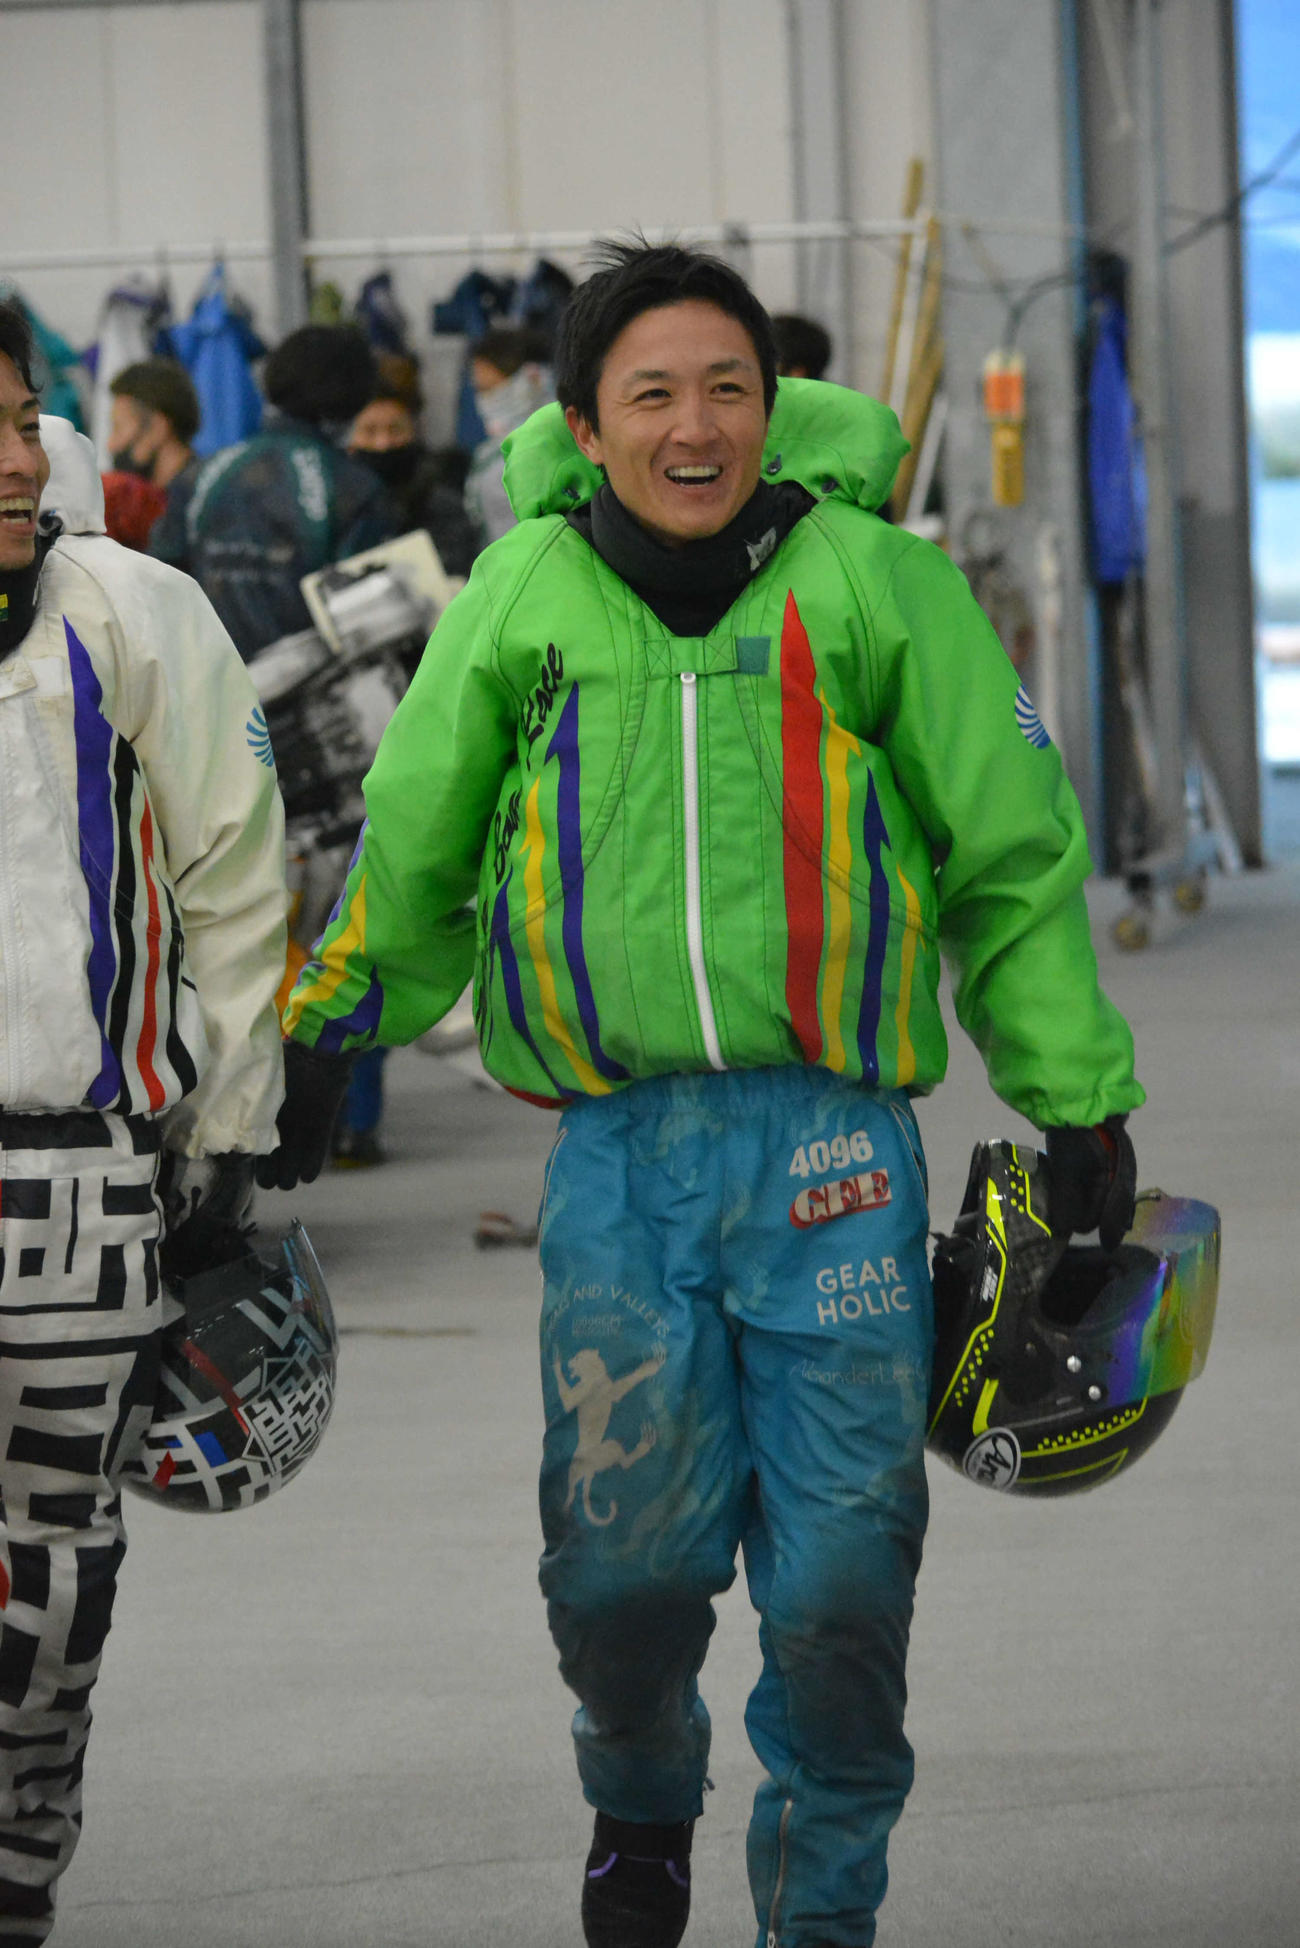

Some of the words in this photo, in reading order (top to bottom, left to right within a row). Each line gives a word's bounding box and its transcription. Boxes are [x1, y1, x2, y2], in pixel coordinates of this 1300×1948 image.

[788, 1130, 874, 1179] 4096
[815, 1256, 901, 1294] GEAR
[815, 1286, 912, 1326] HOLIC
